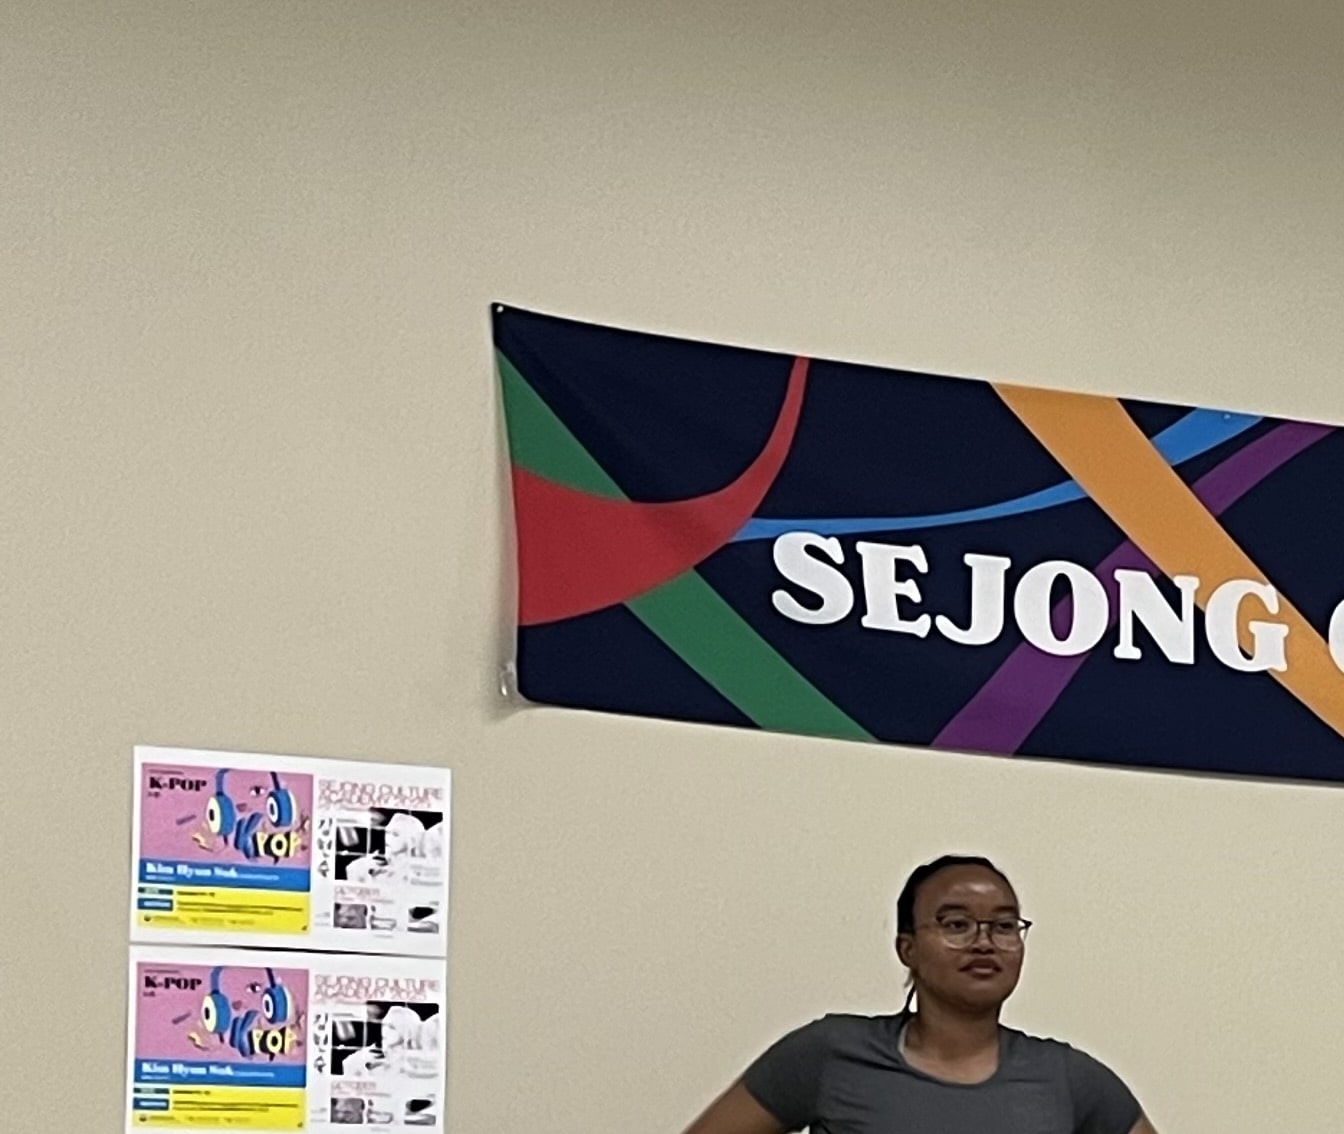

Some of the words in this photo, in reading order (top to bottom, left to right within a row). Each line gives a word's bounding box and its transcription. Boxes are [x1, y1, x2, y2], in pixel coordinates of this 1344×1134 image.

[772, 531, 1289, 679] SEJONG
[149, 776, 207, 792] K-POP
[145, 975, 202, 990] K-POP
